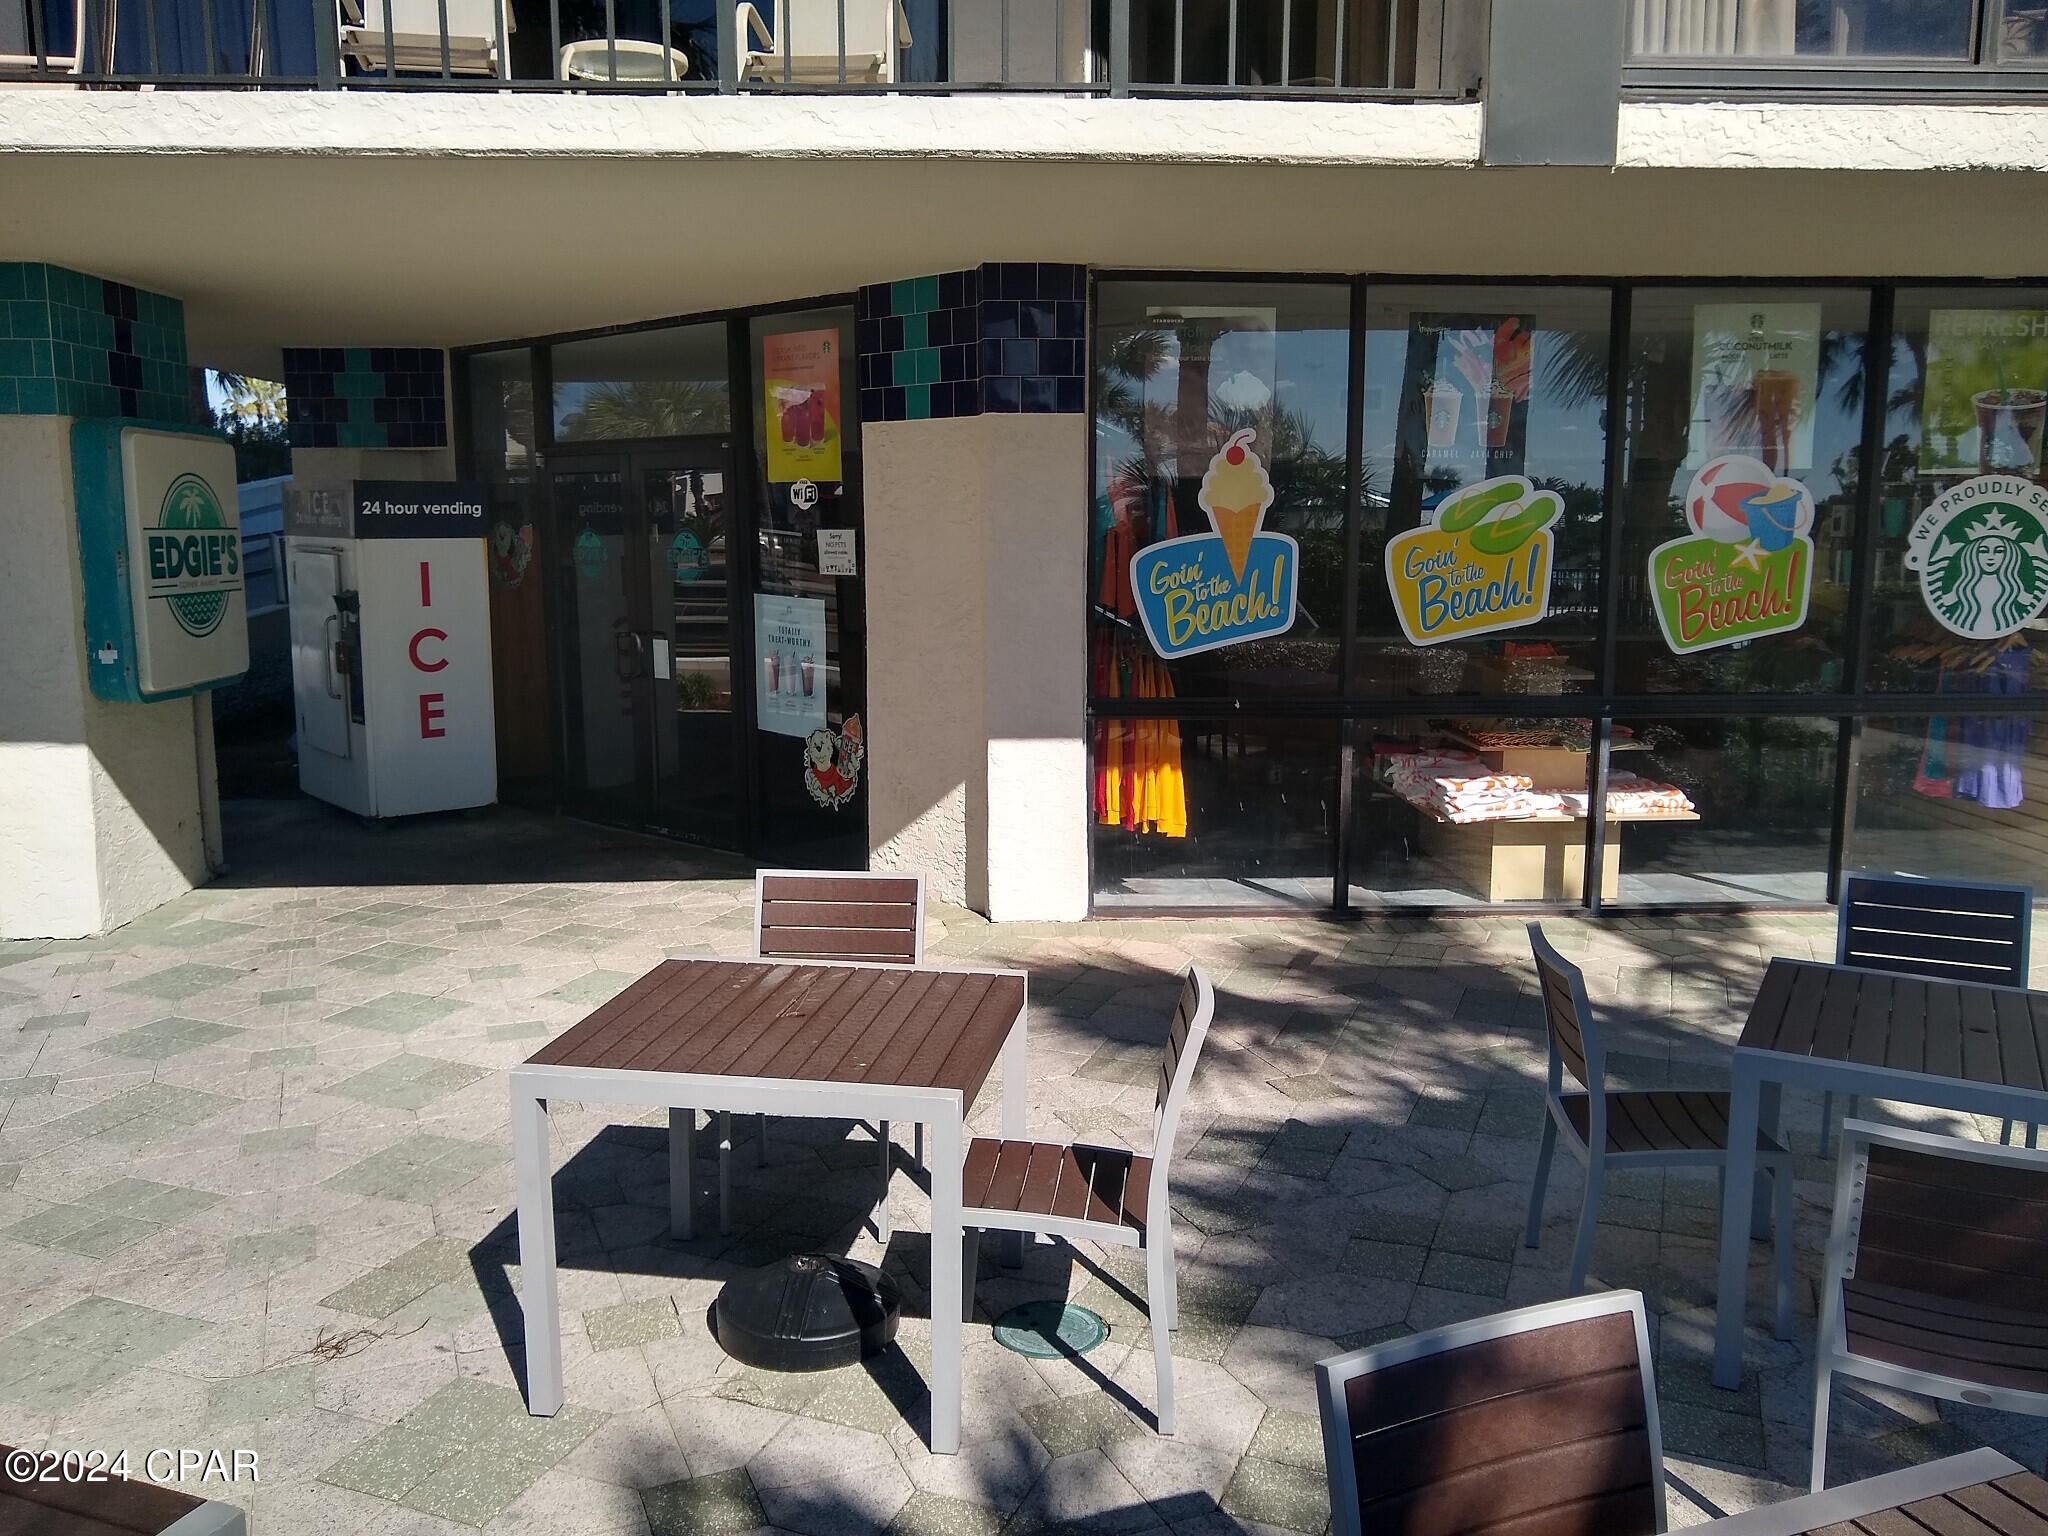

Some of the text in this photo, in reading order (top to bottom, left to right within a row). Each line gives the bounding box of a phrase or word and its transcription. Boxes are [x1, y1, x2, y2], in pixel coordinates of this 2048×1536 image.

[1421, 449, 1460, 459] CARAMEL
[1494, 450, 1514, 459] CHIP
[362, 501, 482, 517] 24 hour vending
[1915, 481, 2048, 541] WE PROUDLY SE
[148, 534, 238, 579] EDGIE'S
[1150, 551, 1204, 594] Goin'
[1404, 537, 1459, 580] Goin'
[1448, 561, 1486, 587] to the
[1664, 545, 1719, 589] Goin'
[1164, 554, 1285, 646] Beach!
[1192, 574, 1231, 601] to the
[1418, 543, 1540, 632] Beach!
[1678, 550, 1801, 643] Beach!
[1706, 571, 1744, 597] to the
[409, 562, 450, 739] ICE
